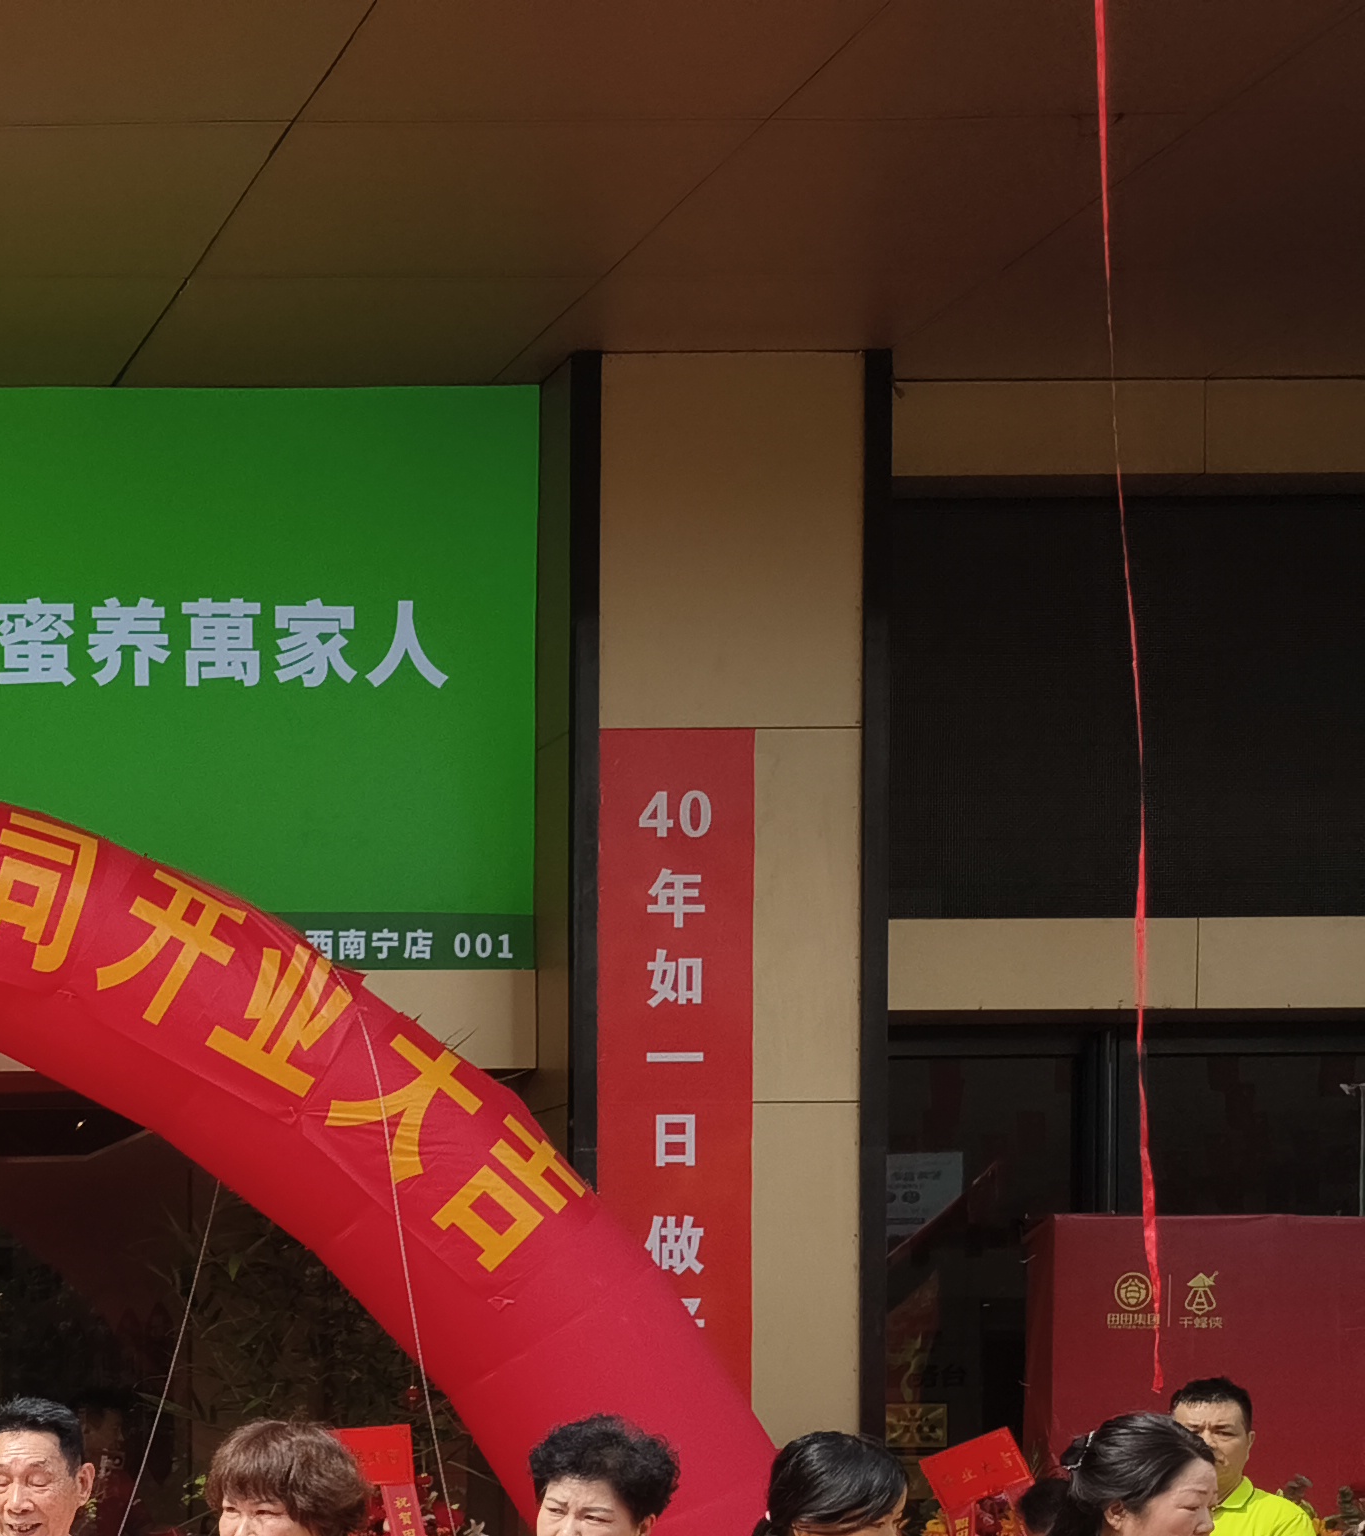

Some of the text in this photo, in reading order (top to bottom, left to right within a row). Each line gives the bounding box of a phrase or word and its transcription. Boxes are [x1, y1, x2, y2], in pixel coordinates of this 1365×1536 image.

[305, 928, 514, 961] 西南宁店 001
[637, 789, 712, 1329] 40年如一日做
[1179, 1316, 1223, 1330] 千蜂侠
